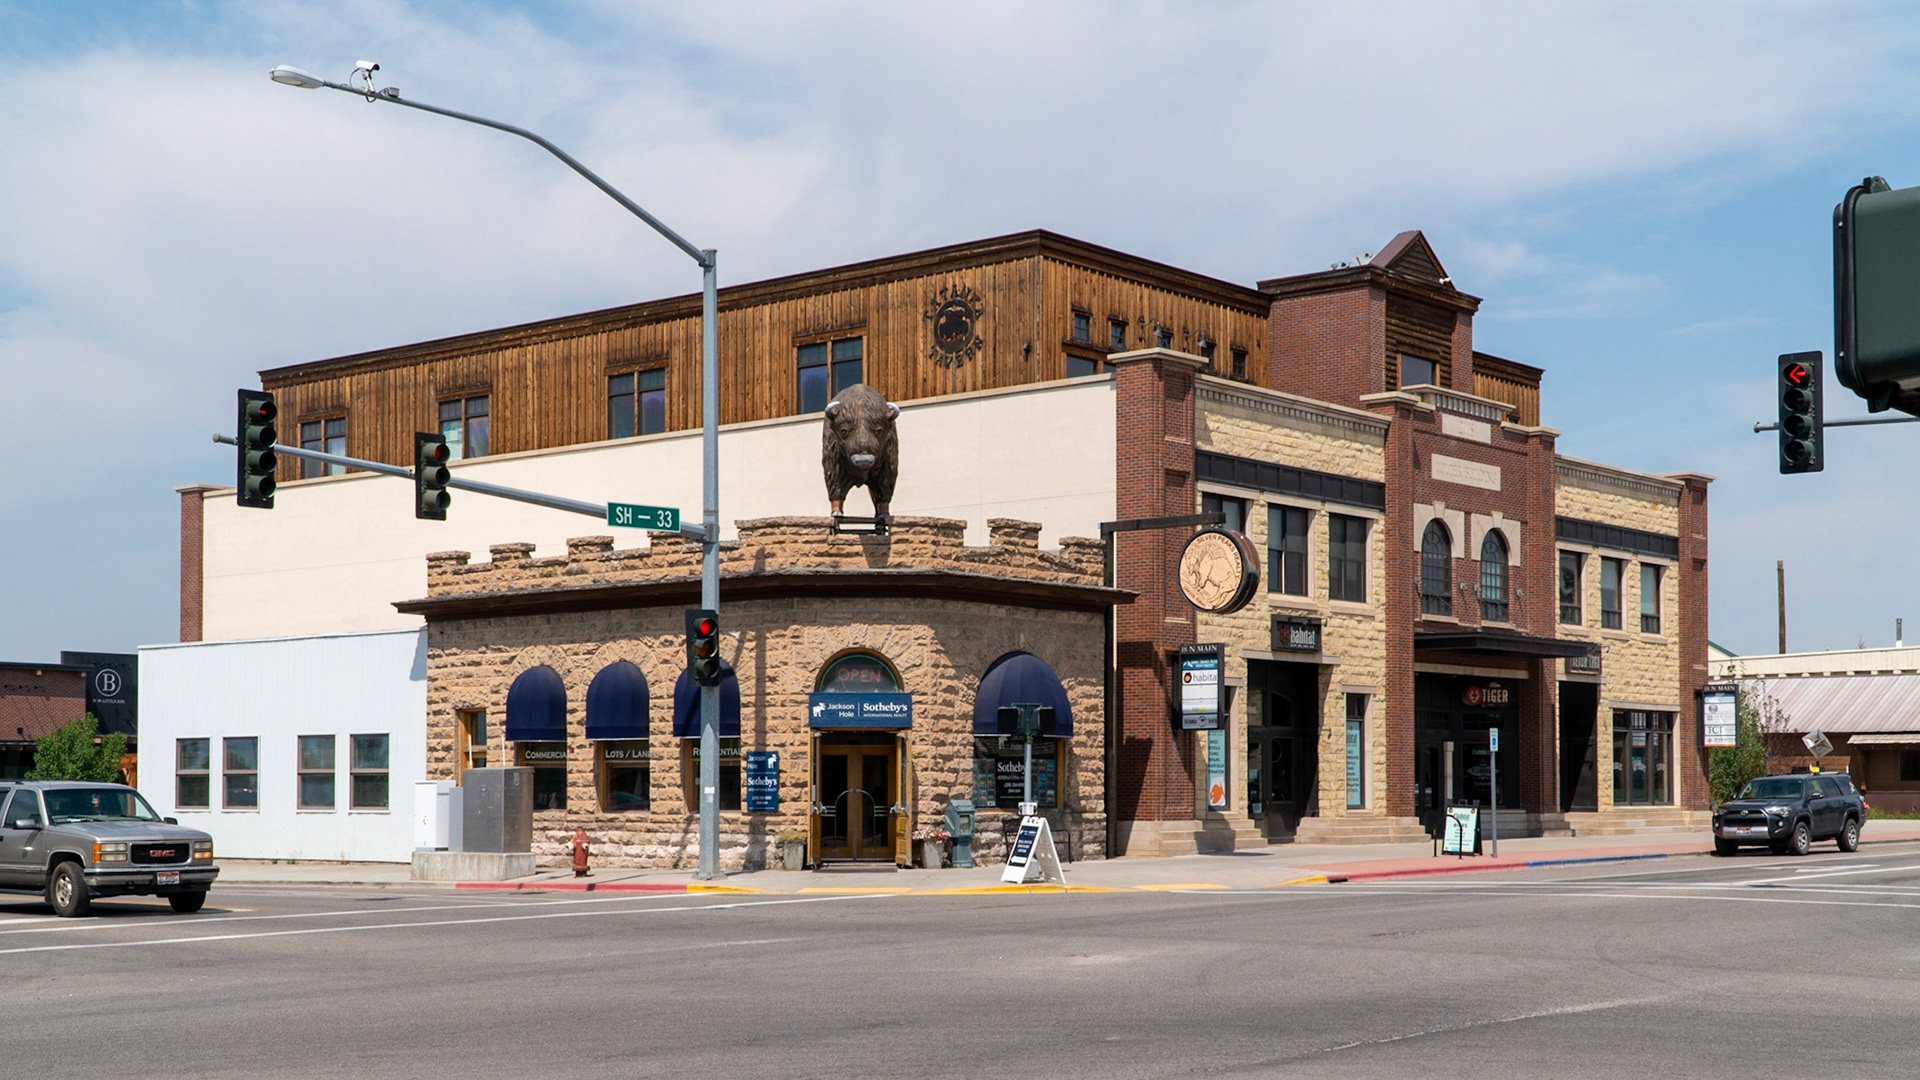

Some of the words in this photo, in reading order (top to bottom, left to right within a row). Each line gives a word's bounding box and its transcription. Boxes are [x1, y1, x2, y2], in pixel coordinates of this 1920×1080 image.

[616, 506, 632, 524] SH
[657, 510, 672, 529] 33
[1197, 534, 1217, 544] SILVER
[1218, 535, 1235, 552] PEAKS
[1233, 552, 1241, 579] REALTY
[1290, 626, 1316, 645] habitat
[1189, 645, 1196, 653] N
[1197, 644, 1218, 652] MAIN
[838, 667, 882, 683] OPEN
[1193, 672, 1217, 682] habita
[102, 673, 116, 691] B
[1482, 688, 1508, 703] TIGER
[863, 702, 908, 713] Sotheby's
[525, 750, 567, 759] COMMERCIA
[605, 750, 624, 759] LOTS
[747, 776, 778, 788] Sotheby's
[149, 849, 176, 857] GMC
